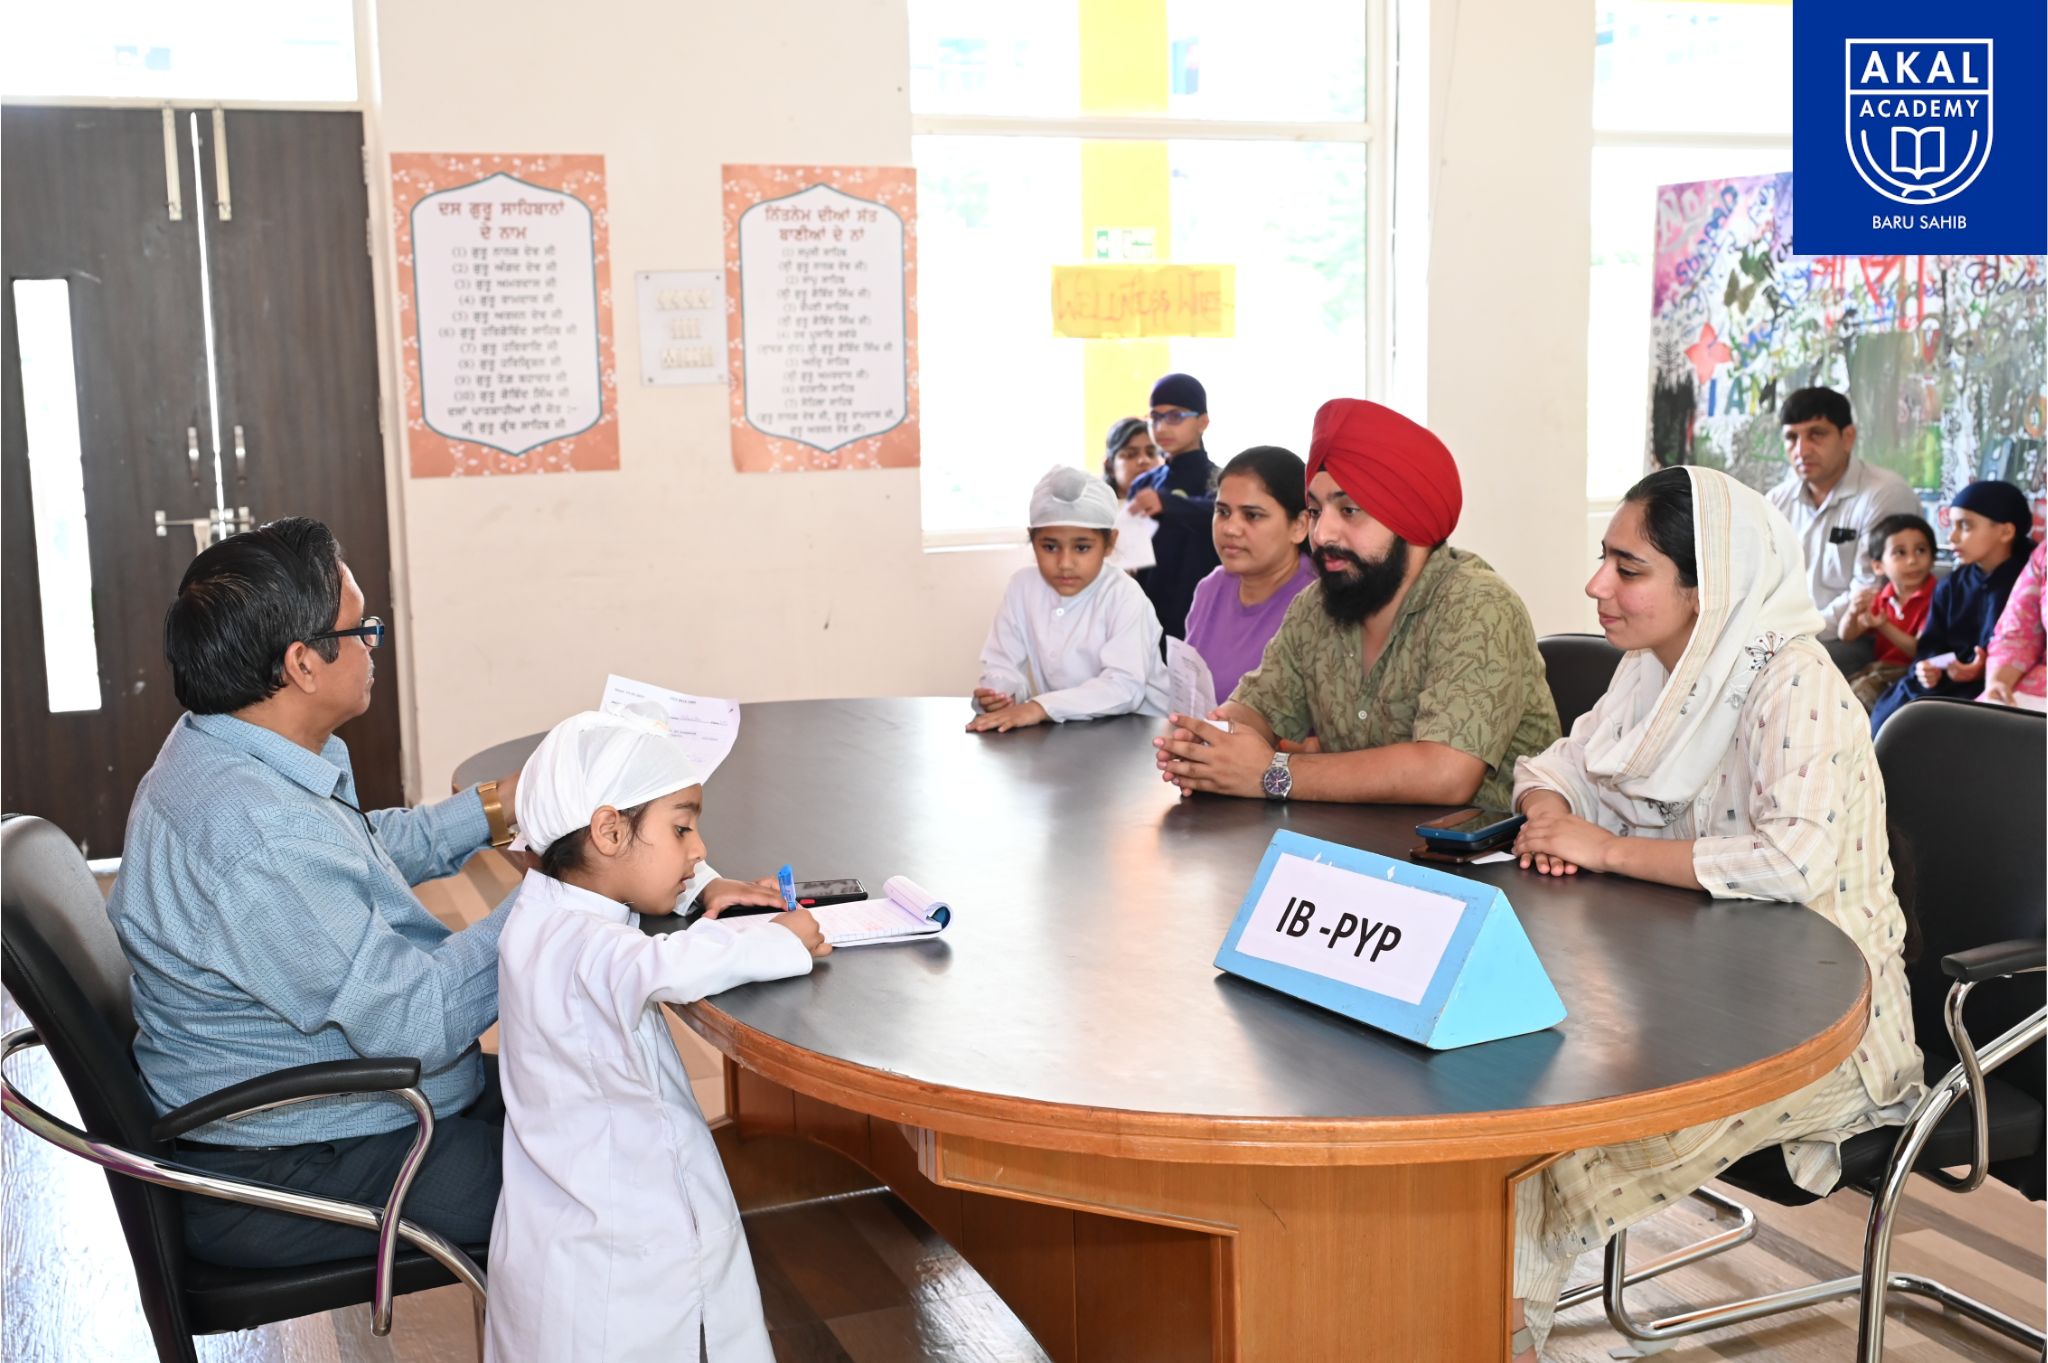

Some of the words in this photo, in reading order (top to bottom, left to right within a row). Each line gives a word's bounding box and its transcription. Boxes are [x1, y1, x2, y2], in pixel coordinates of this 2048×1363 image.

[438, 202, 461, 216] ਦਸ
[469, 202, 493, 221] ਗੁਰੂ
[480, 222, 491, 240] ਦੇ
[499, 226, 528, 239] ਨਾਮ
[833, 226, 843, 241] ਦੇ
[1275, 896, 1316, 938] IB
[1319, 912, 1402, 963] -PYP
